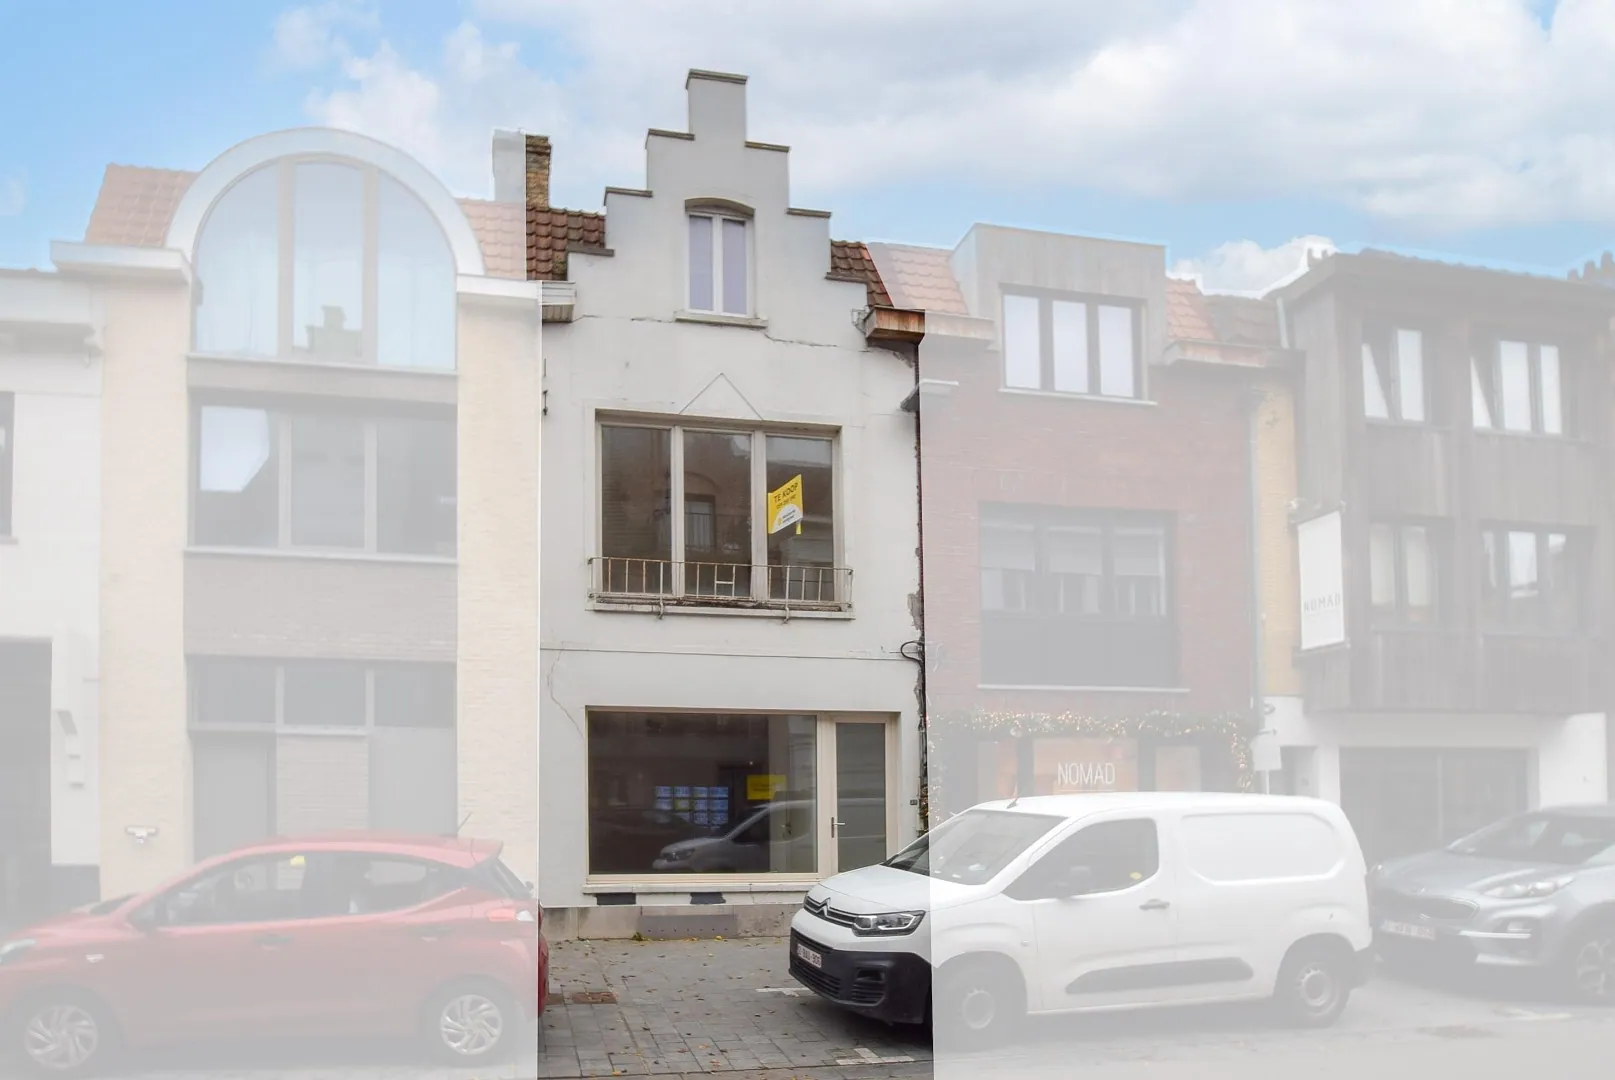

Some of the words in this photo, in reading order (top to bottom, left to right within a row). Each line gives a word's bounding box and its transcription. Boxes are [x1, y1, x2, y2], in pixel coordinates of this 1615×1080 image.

[774, 493, 781, 503] TE
[782, 482, 798, 498] KOOP
[1304, 593, 1341, 612] NOMAD
[1057, 762, 1115, 785] NOMAD
